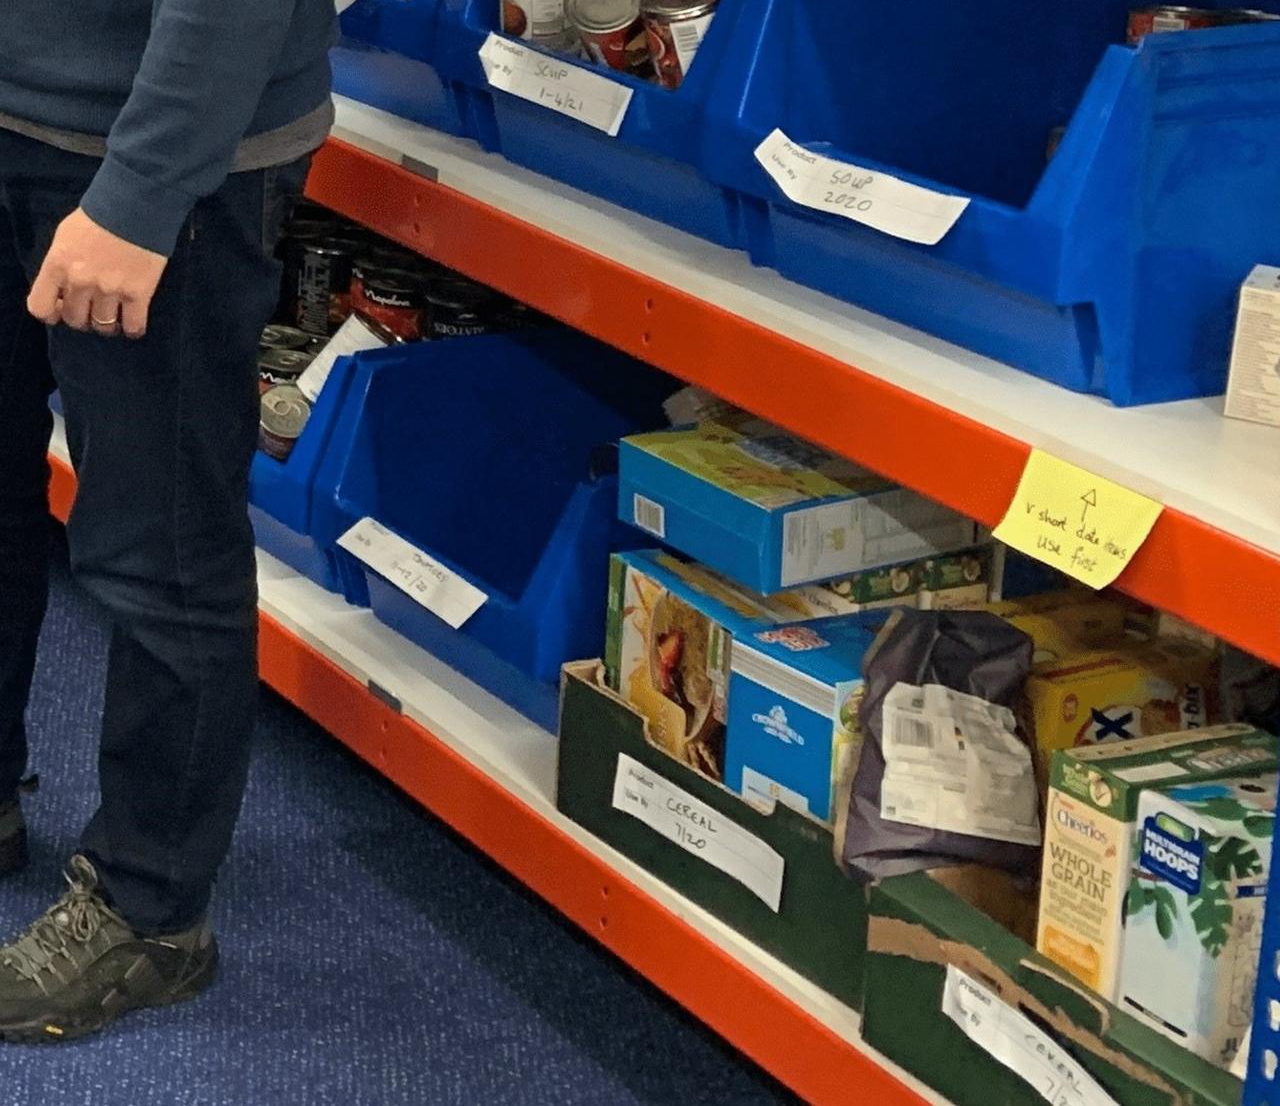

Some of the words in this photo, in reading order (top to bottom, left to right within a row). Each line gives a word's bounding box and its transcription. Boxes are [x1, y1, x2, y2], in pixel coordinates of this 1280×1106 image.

[495, 40, 525, 58] Product
[534, 60, 569, 81] SOUP
[783, 142, 818, 165] Product
[829, 171, 874, 191] SOUP
[823, 191, 873, 212] 2020
[1038, 508, 1068, 532] short
[1076, 521, 1100, 545] date
[1070, 546, 1098, 573] first
[627, 767, 656, 790] Product
[666, 796, 718, 833] CEREAL
[1056, 808, 1108, 844] Cheerios
[675, 821, 707, 850] 7/20
[1145, 827, 1201, 866] MULTIGRAIN
[1049, 842, 1113, 889] WHOLE
[1144, 838, 1200, 881] HOOPS
[1051, 862, 1106, 904] GRAIN
